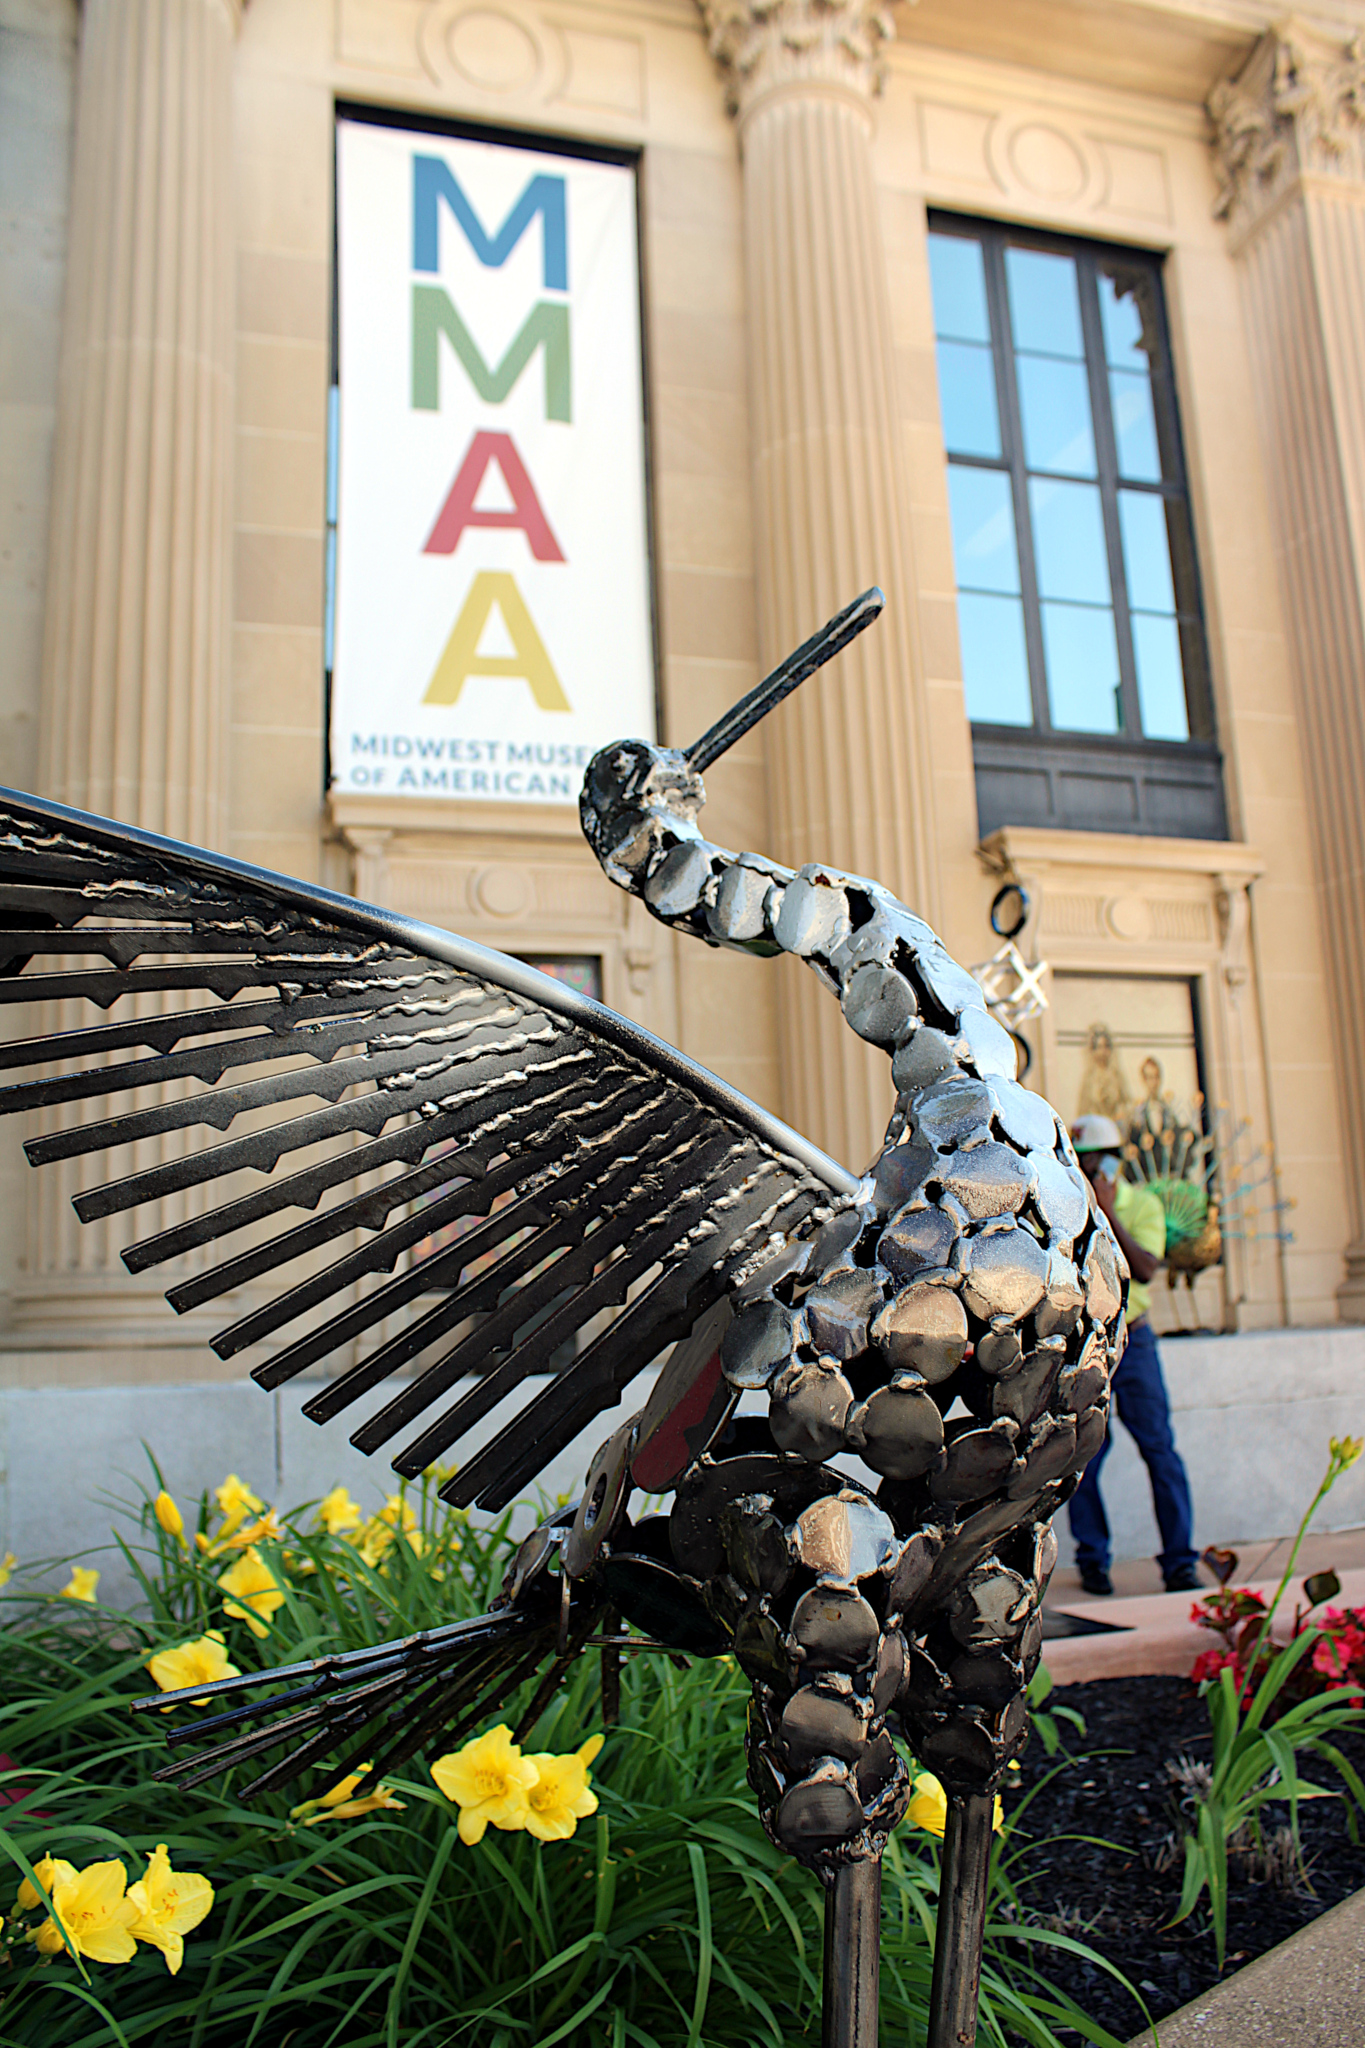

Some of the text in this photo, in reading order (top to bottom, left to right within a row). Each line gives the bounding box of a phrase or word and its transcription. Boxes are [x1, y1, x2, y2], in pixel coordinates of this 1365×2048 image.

[411, 152, 573, 713] MMAA
[351, 733, 597, 768] MIDWEST MUSE
[350, 766, 571, 795] OF AMERICAN
